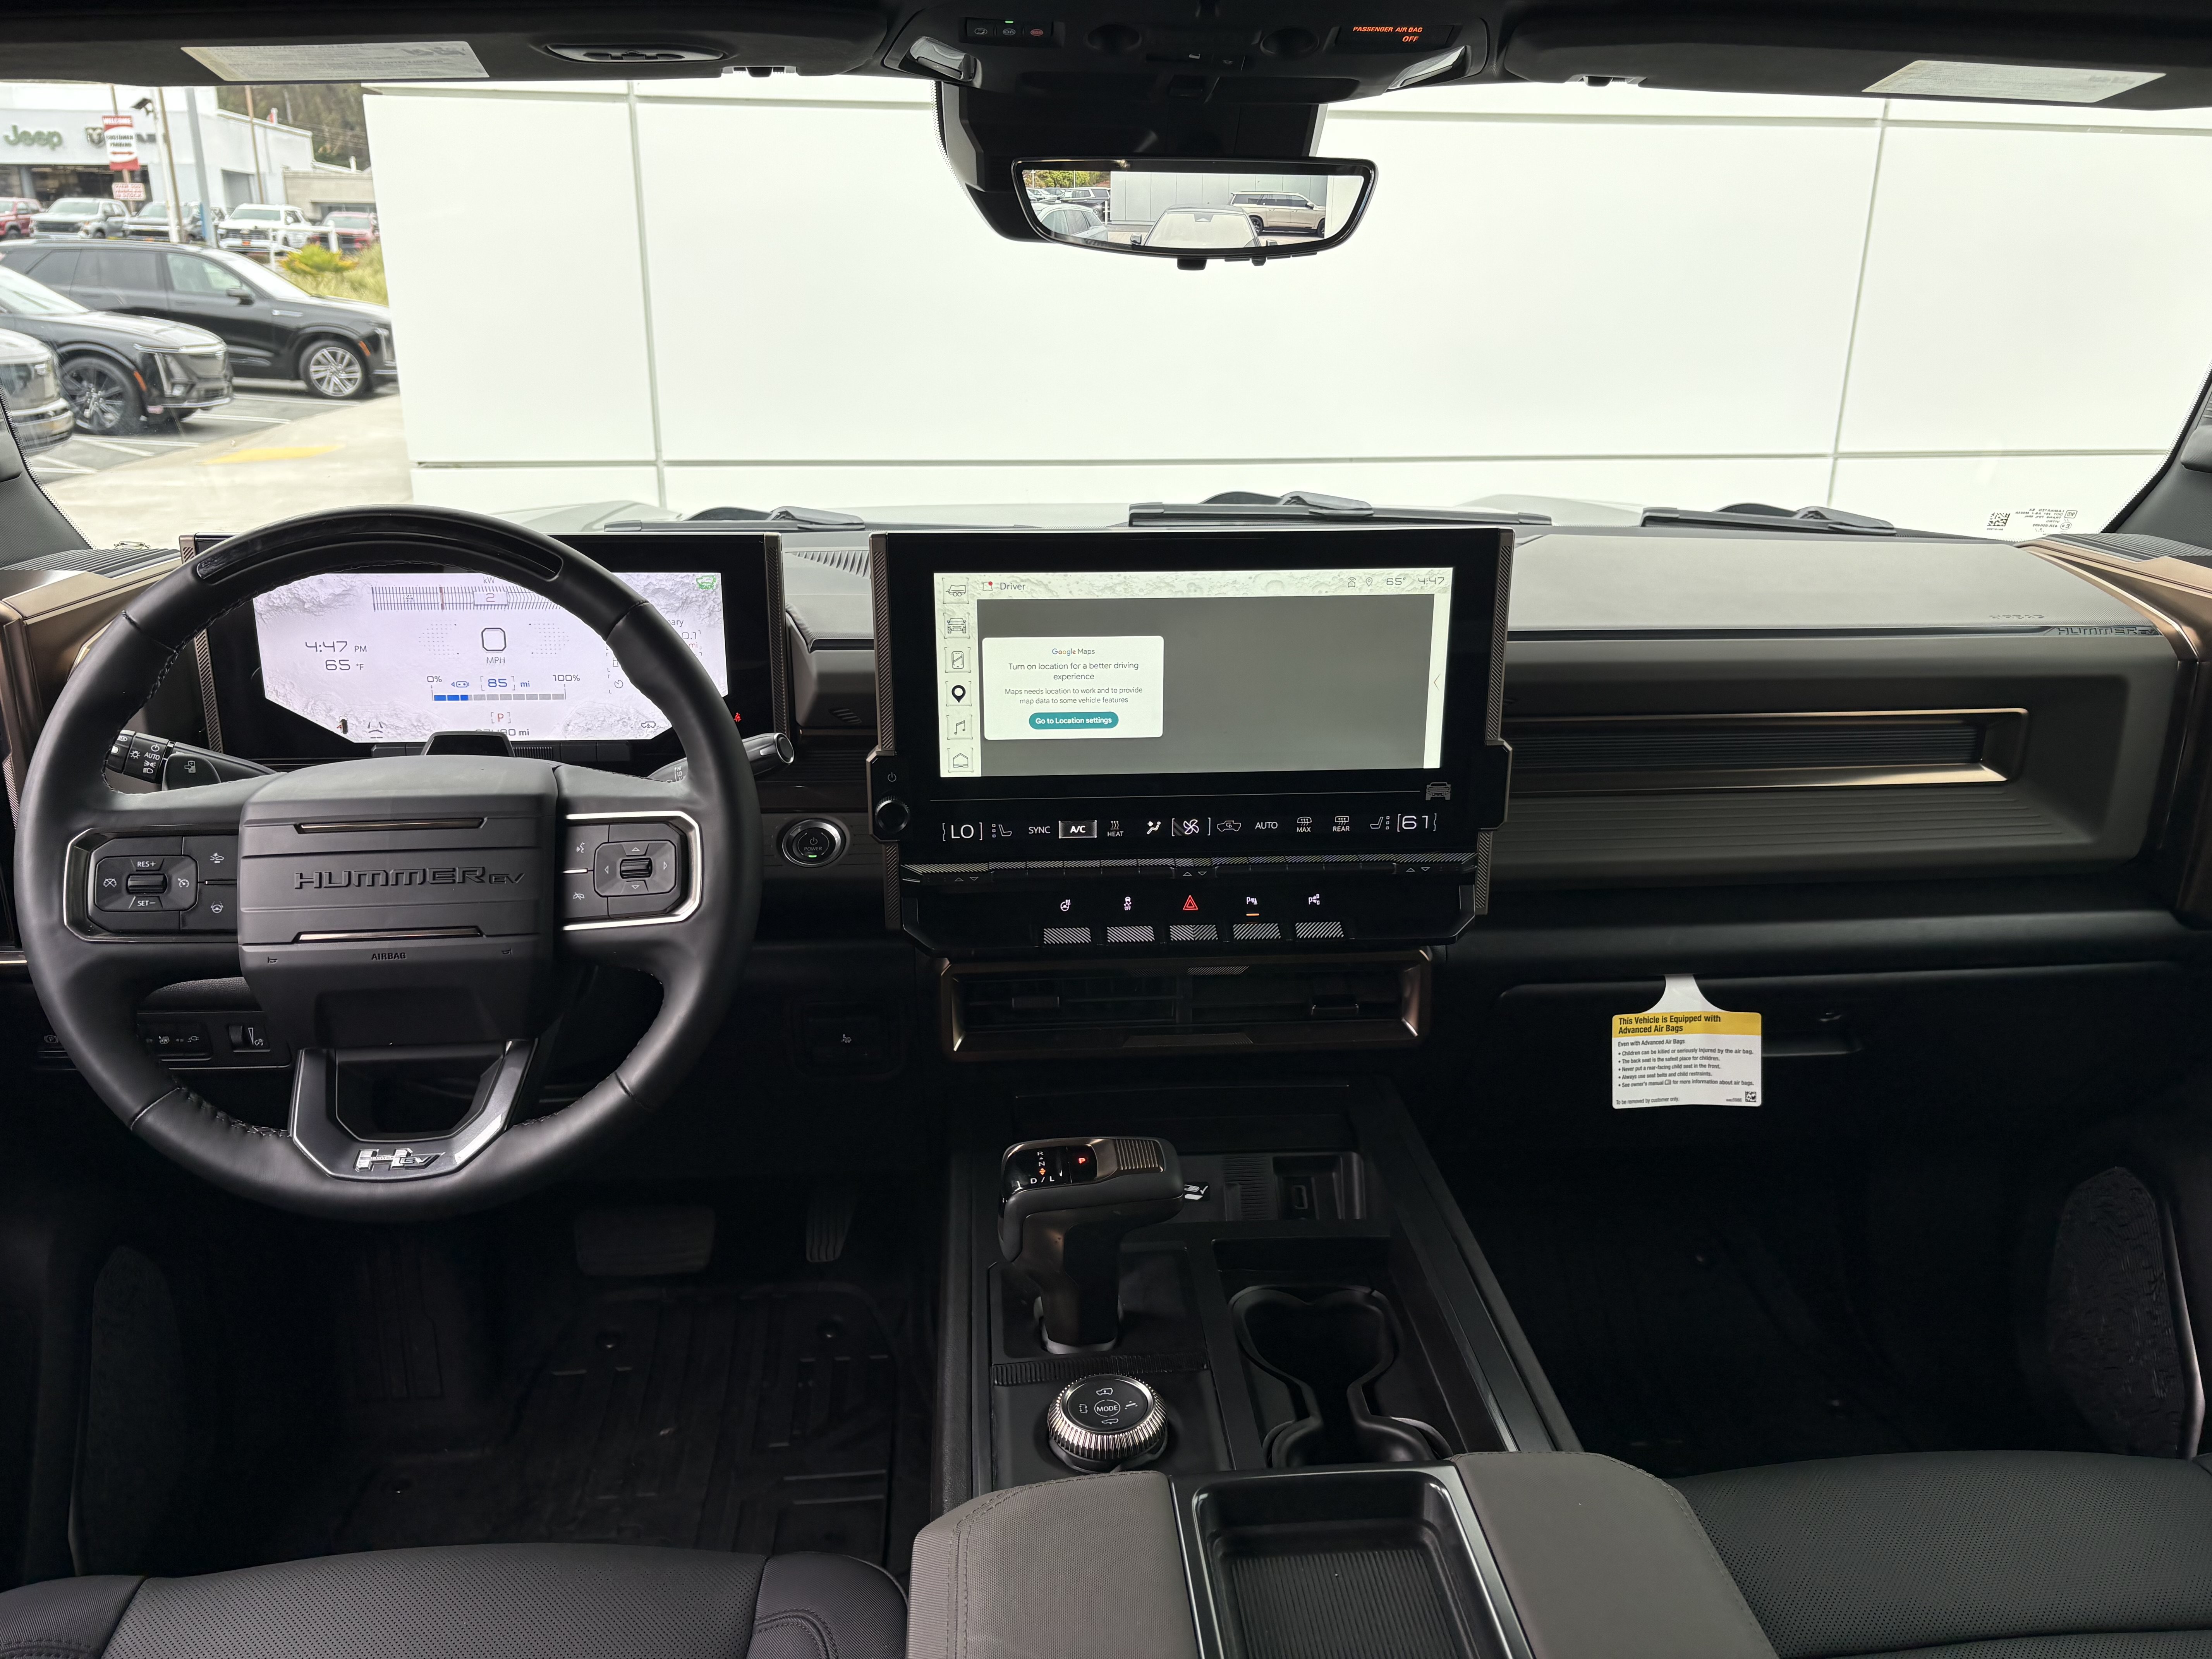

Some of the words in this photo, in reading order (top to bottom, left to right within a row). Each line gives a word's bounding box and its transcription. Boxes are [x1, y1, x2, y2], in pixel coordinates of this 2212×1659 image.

[3, 125, 62, 151] Jeep
[1418, 577, 1445, 585] 4:47
[1000, 582, 1025, 591] Driver
[486, 593, 495, 602] 2
[2057, 627, 2138, 635] HUMMER
[305, 641, 347, 652] 4:47
[325, 659, 350, 670] 65
[1053, 673, 1094, 681] experience
[488, 678, 508, 687] 85
[498, 713, 503, 722] P
[144, 752, 160, 760] AUTO
[1255, 821, 1278, 830] AUTO
[1402, 815, 1429, 830] 61
[951, 824, 974, 839] LO
[1028, 826, 1051, 835] SYNC
[1070, 825, 1086, 834] A/C
[294, 866, 486, 890] HUMMER
[489, 872, 526, 885] EV
[371, 951, 406, 961] AIRBAG
[1635, 1016, 1659, 1024] Vehicle
[1670, 1014, 1702, 1024] Equipped
[1618, 1025, 1652, 1034] Advanced
[1666, 1025, 1683, 1033] Bags
